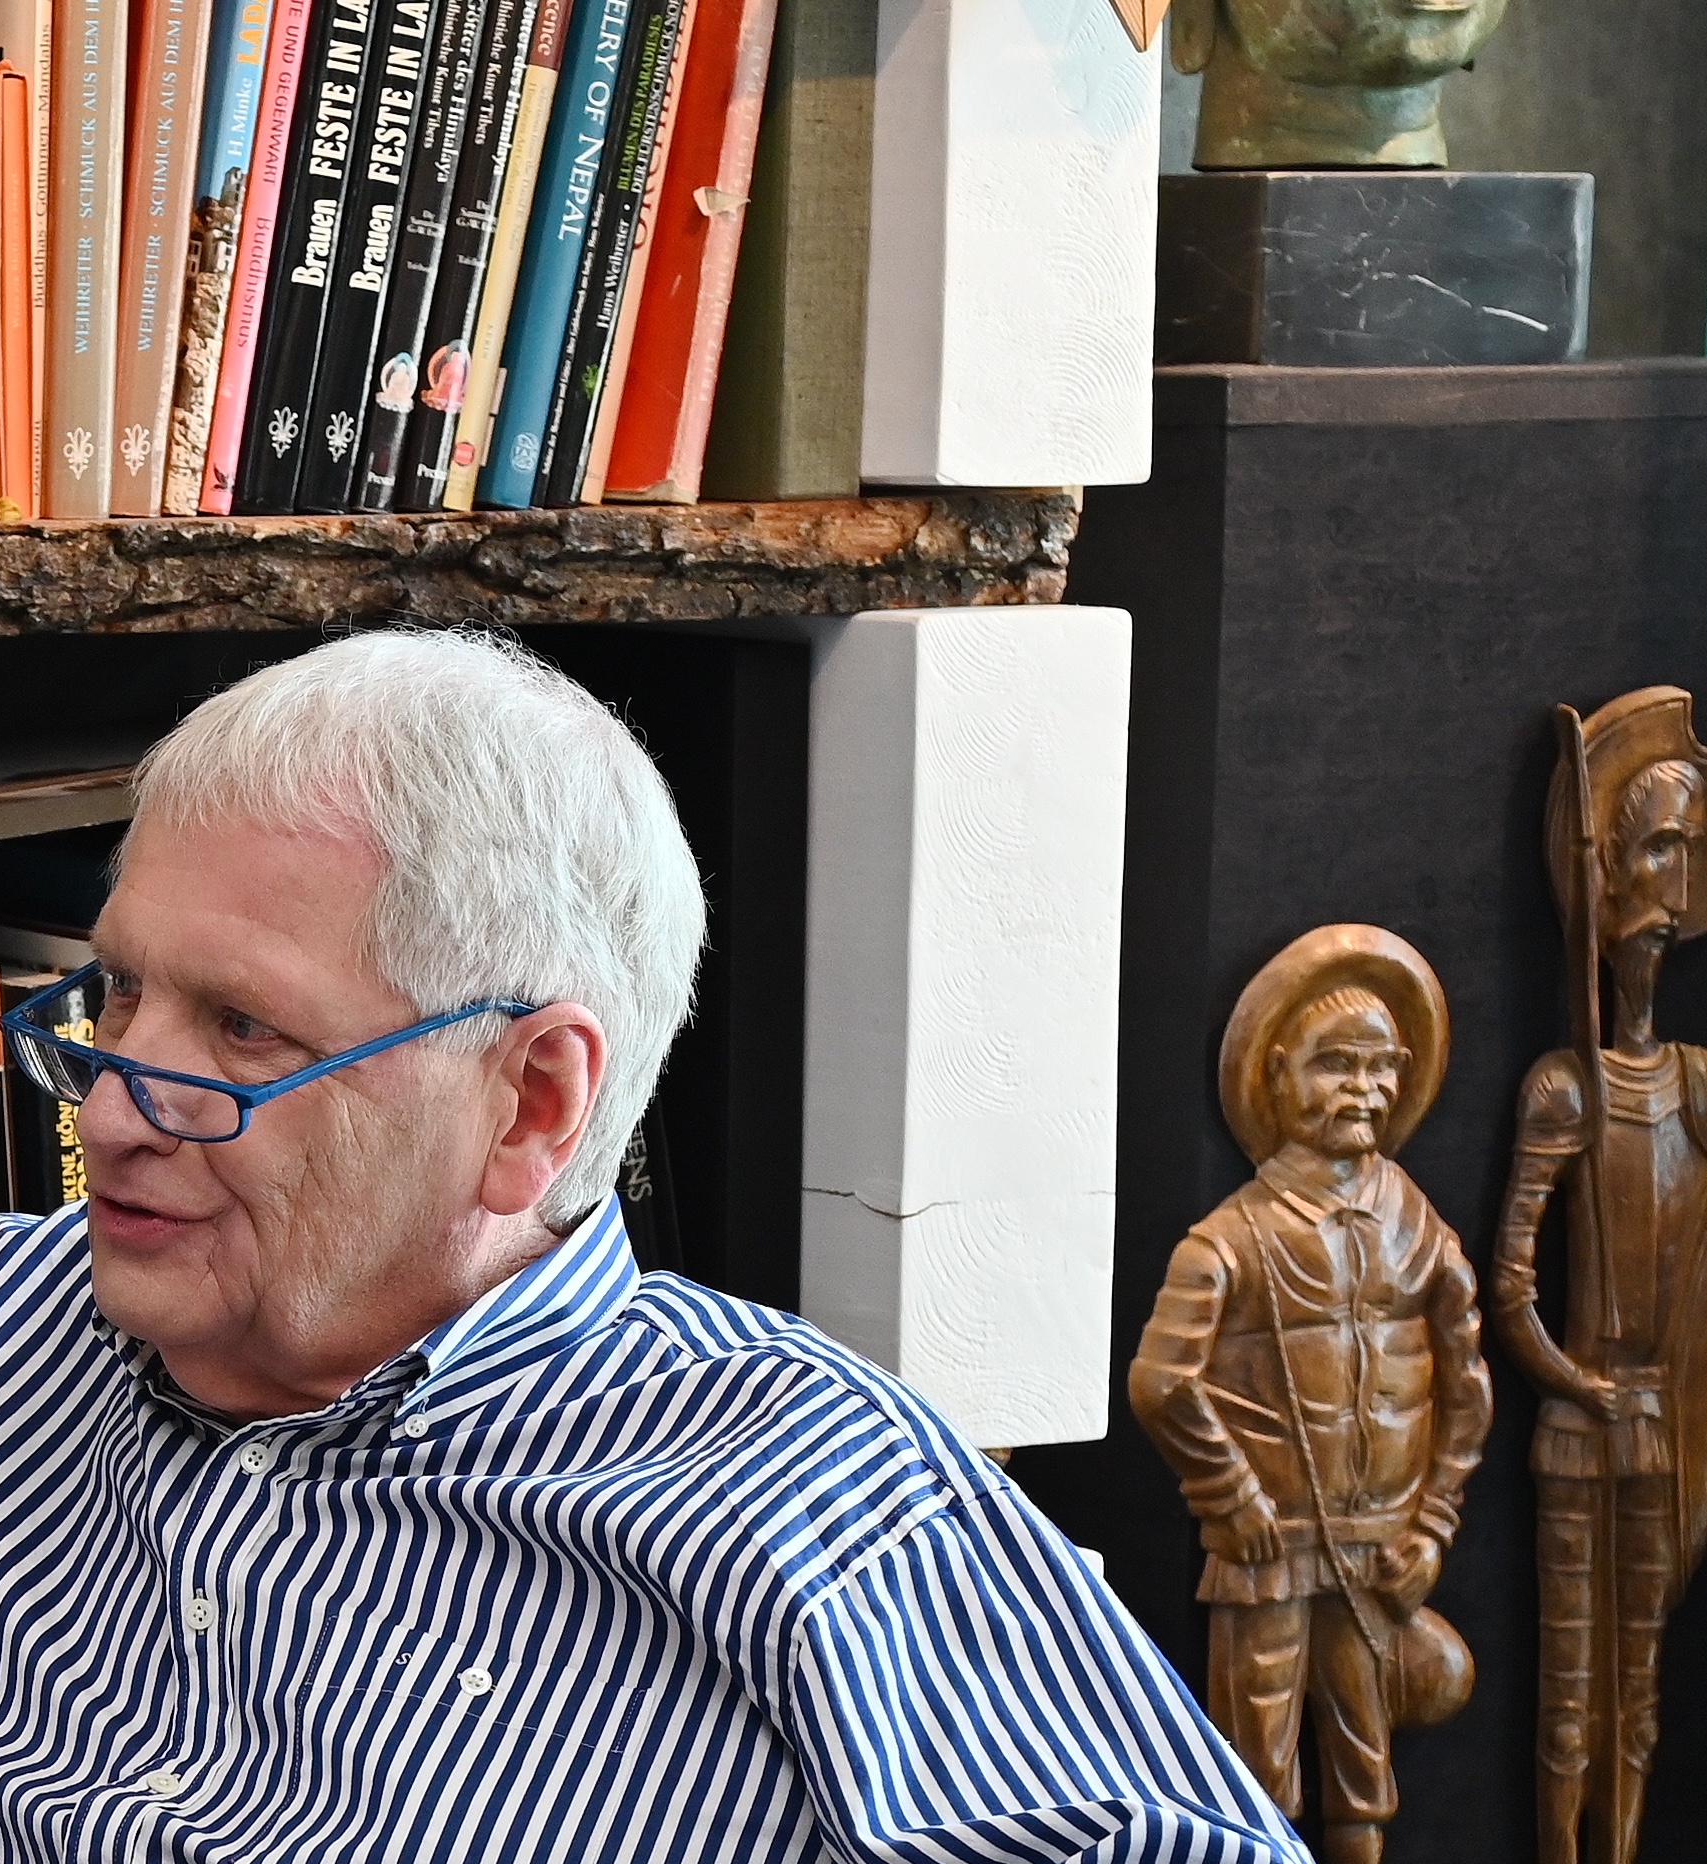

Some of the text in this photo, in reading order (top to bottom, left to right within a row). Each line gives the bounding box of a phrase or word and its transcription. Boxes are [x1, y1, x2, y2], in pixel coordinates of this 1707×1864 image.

[34, 23, 52, 309] Buddhas Mandalas
[264, 71, 292, 186] GEGENWART
[291, 40, 364, 288] Brauen FESTE IN
[583, 81, 611, 127] OF
[75, 19, 101, 354] WEIHRETER SCHMUCK AUS DEM
[557, 132, 605, 242] NEPAL
[238, 216, 273, 349] Buddhismus
